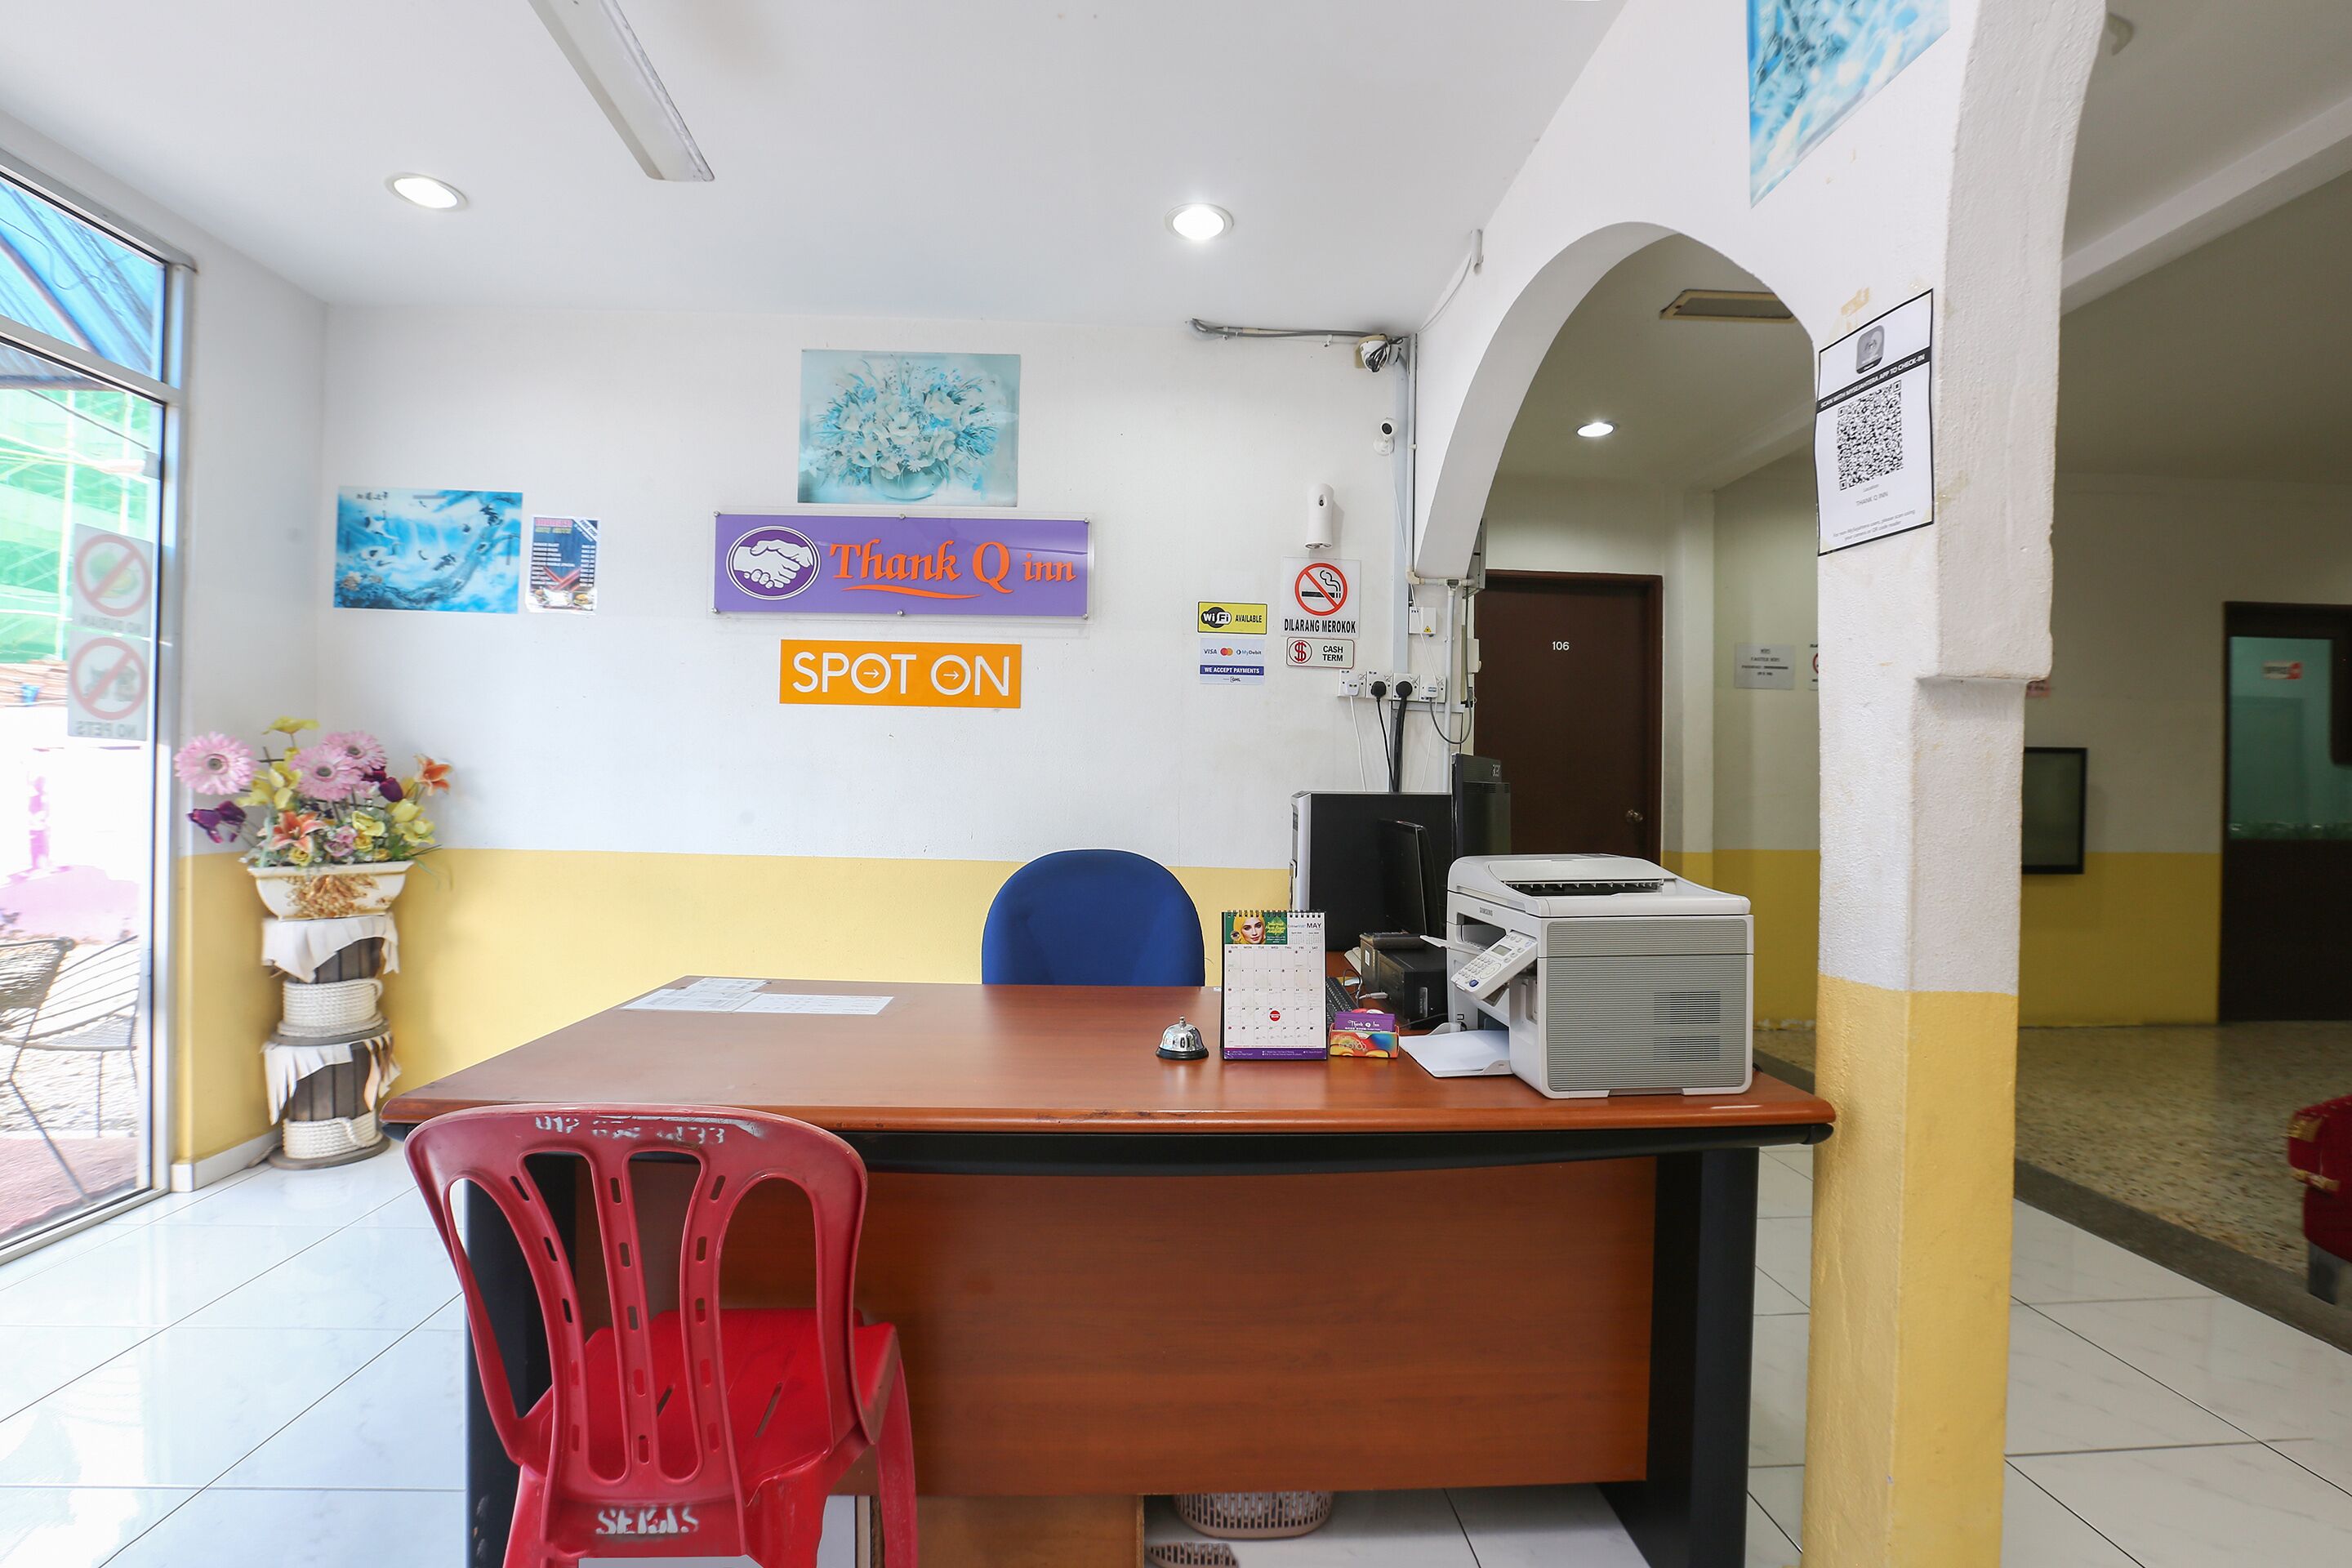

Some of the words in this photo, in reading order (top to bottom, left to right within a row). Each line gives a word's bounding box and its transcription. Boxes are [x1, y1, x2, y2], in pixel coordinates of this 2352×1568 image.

[1898, 354, 1926, 369] CHECK-IN
[830, 539, 961, 581] Thank
[972, 541, 1013, 594] Q
[1022, 552, 1076, 581] inn
[1235, 614, 1263, 623] AVAILABLE
[1284, 619, 1320, 632] DILARANG
[1321, 621, 1356, 633] MEROKOK
[1323, 645, 1343, 653] CASH
[1552, 641, 1570, 650] 106
[1322, 653, 1343, 662] TERM
[792, 652, 916, 694] SPOT
[930, 654, 1009, 696] ON
